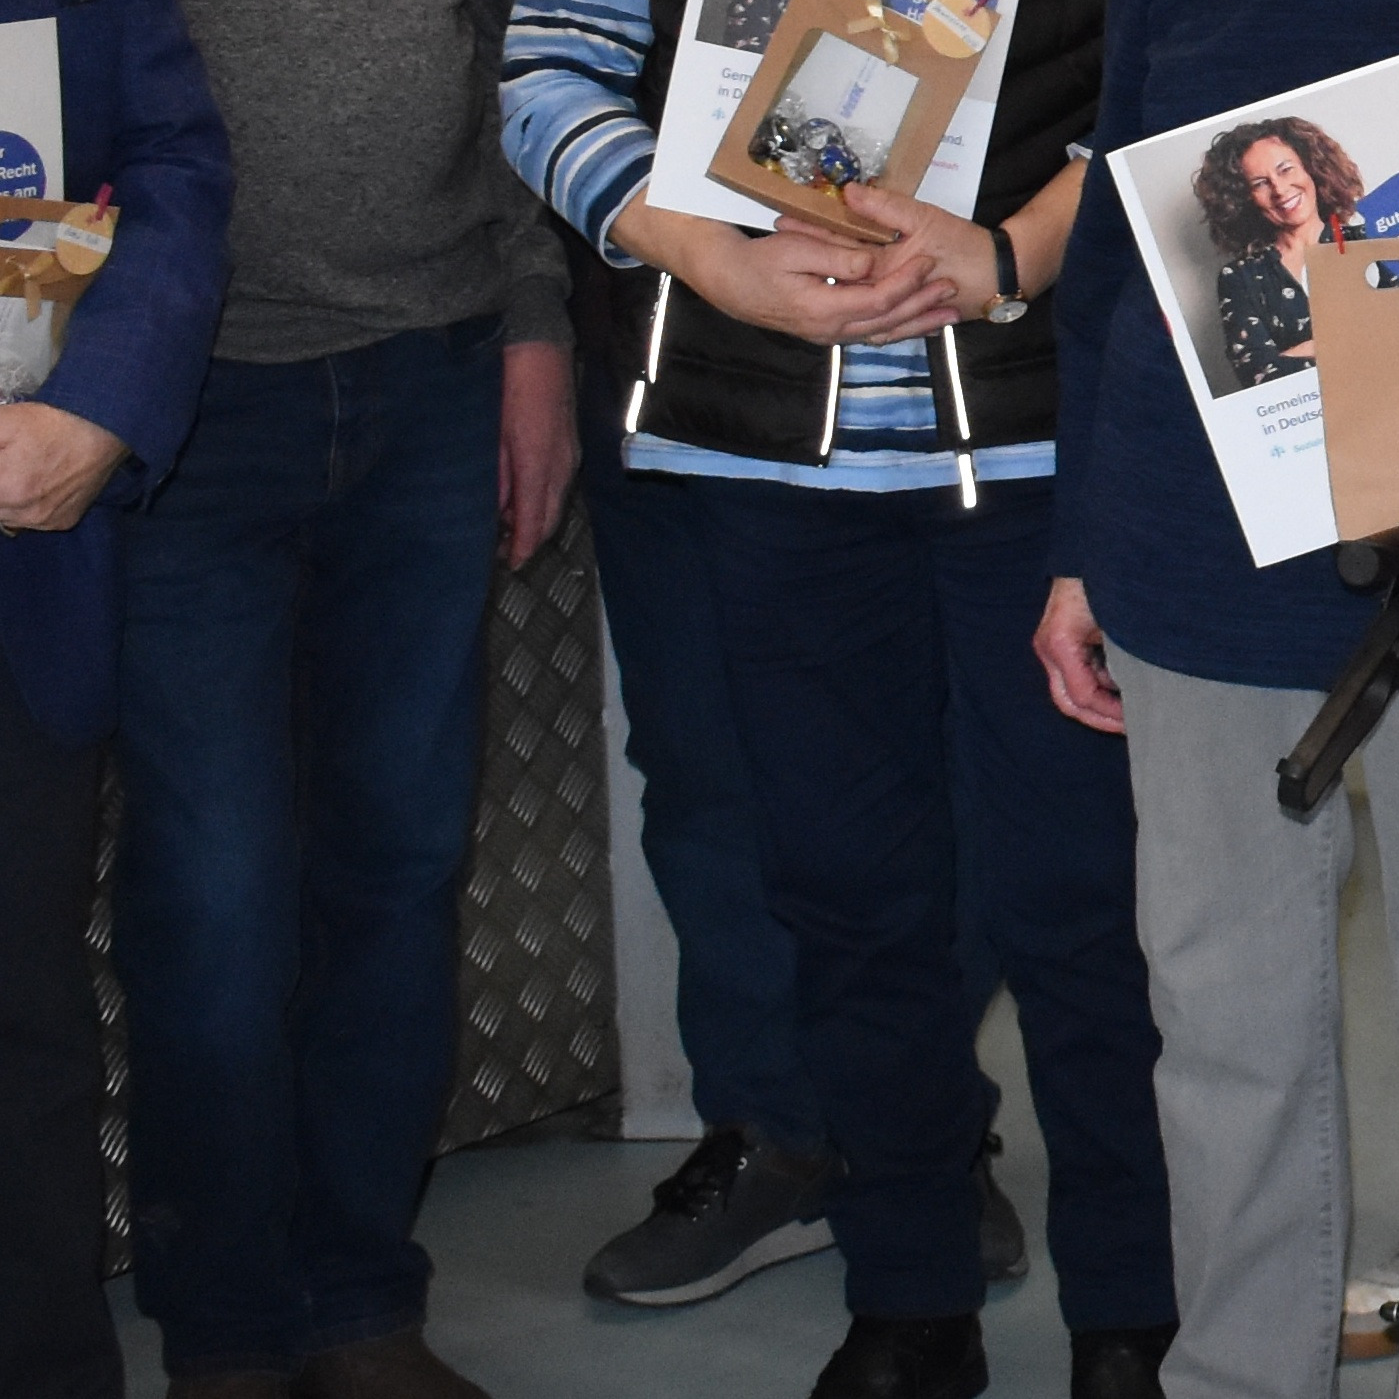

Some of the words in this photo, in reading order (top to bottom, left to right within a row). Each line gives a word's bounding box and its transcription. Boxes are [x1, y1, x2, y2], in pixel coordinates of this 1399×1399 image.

[1256, 391, 1320, 417] Gemeins
[1262, 424, 1277, 435] in
[1278, 408, 1324, 430] Deutsc
